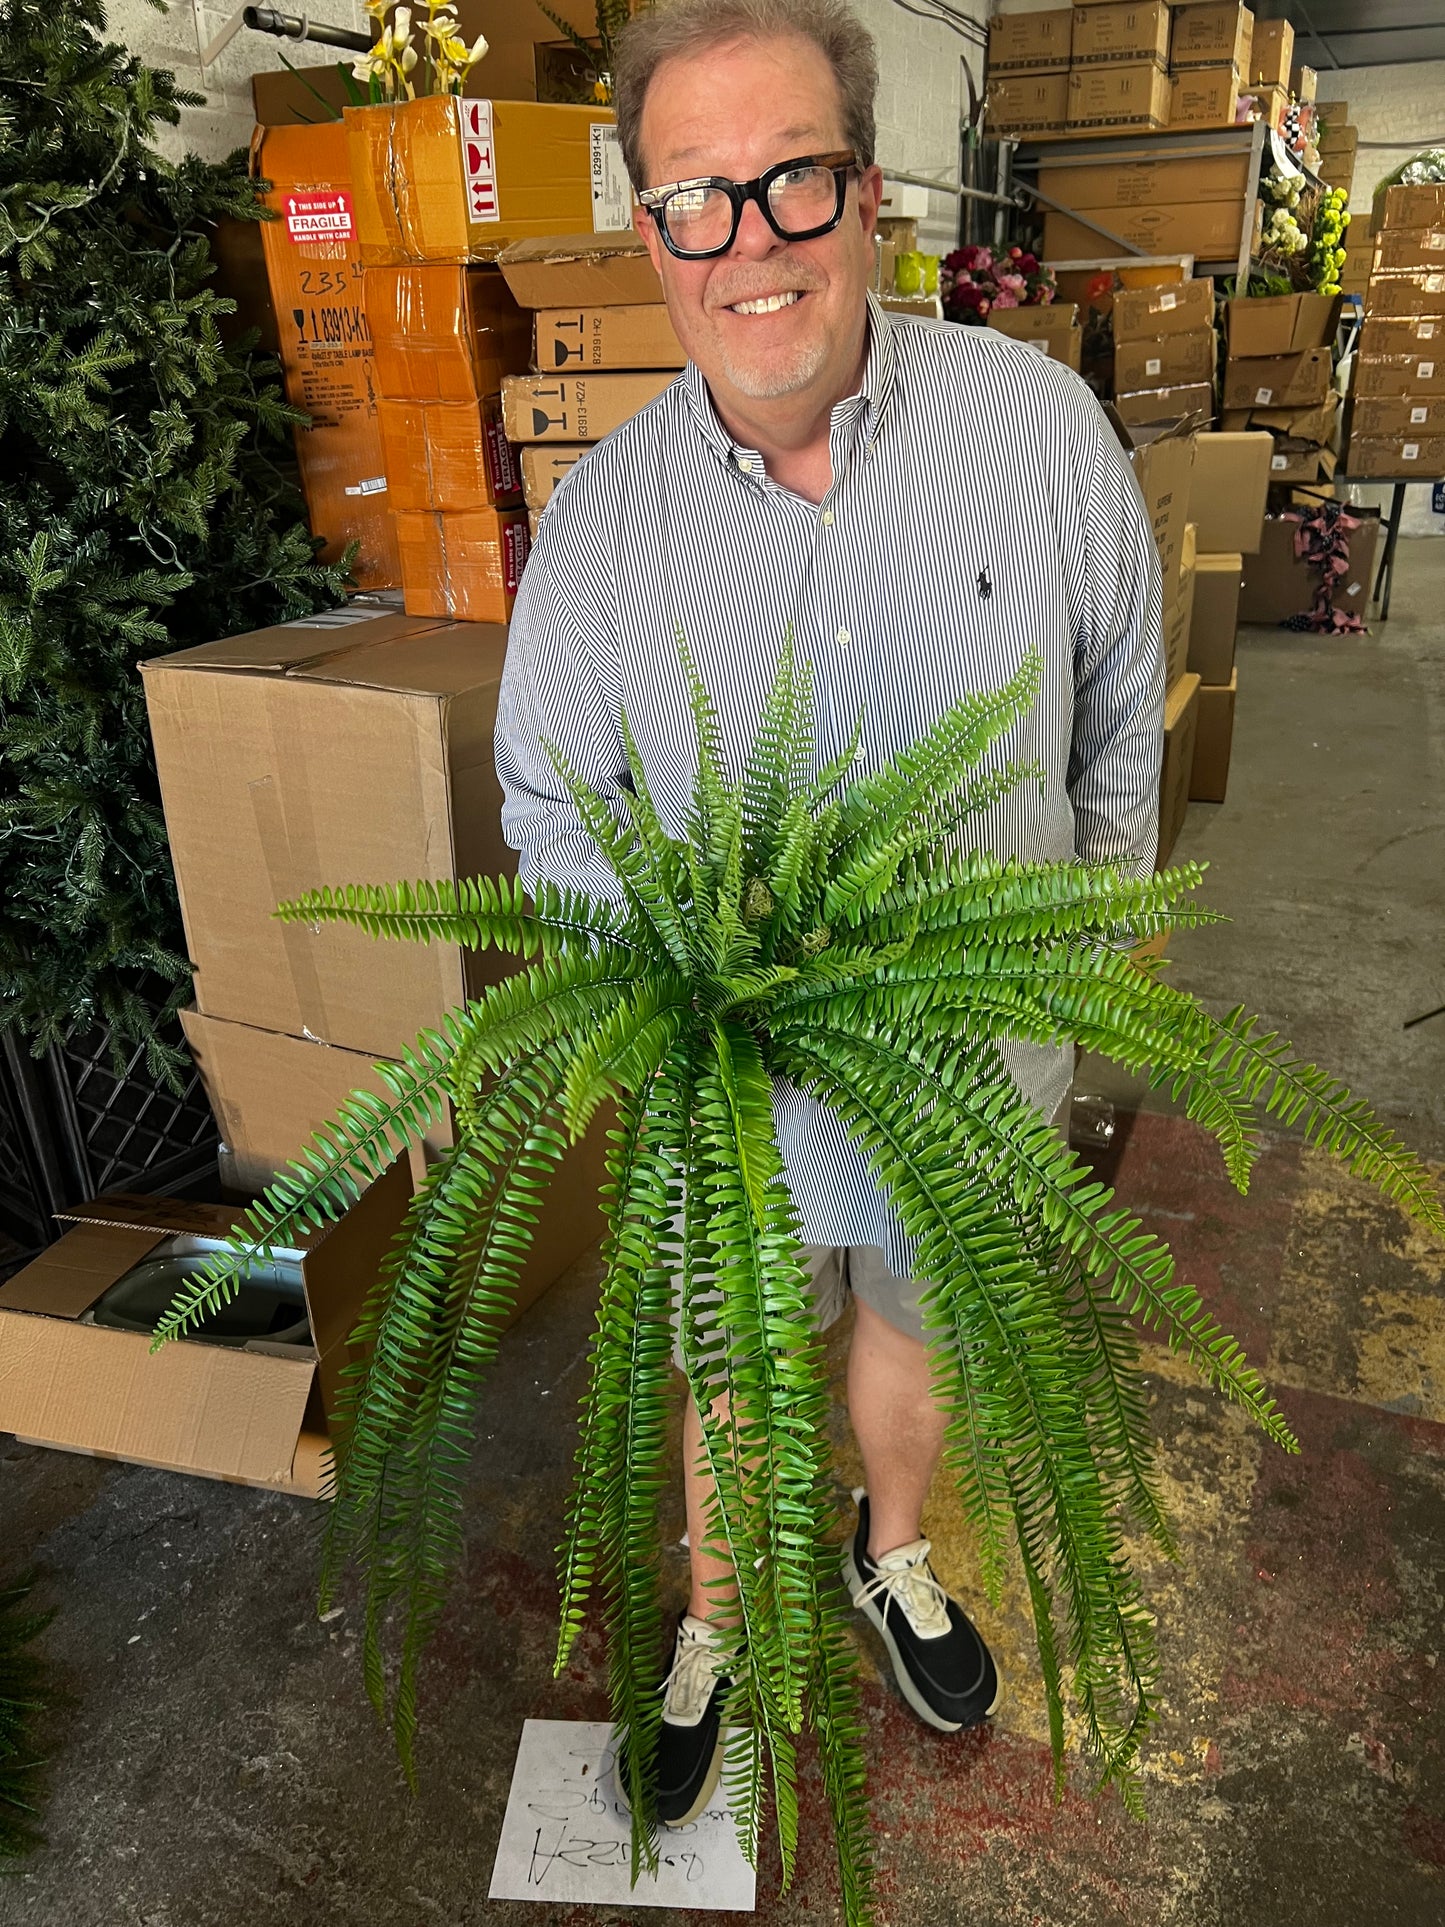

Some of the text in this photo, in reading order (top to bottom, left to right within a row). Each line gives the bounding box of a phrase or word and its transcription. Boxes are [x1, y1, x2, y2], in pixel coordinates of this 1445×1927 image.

[593, 128, 602, 175] 82991-K1
[298, 201, 336, 211] THIS SIDE UP
[293, 216, 348, 229] FRAGILE
[294, 231, 351, 241] HANDLE WITH CARE
[299, 270, 347, 296] 235
[592, 318, 602, 365] 82991-K2
[575, 381, 588, 437] 83913-K2/2
[497, 427, 511, 486] FRAGILE
[508, 538, 514, 547] UP
